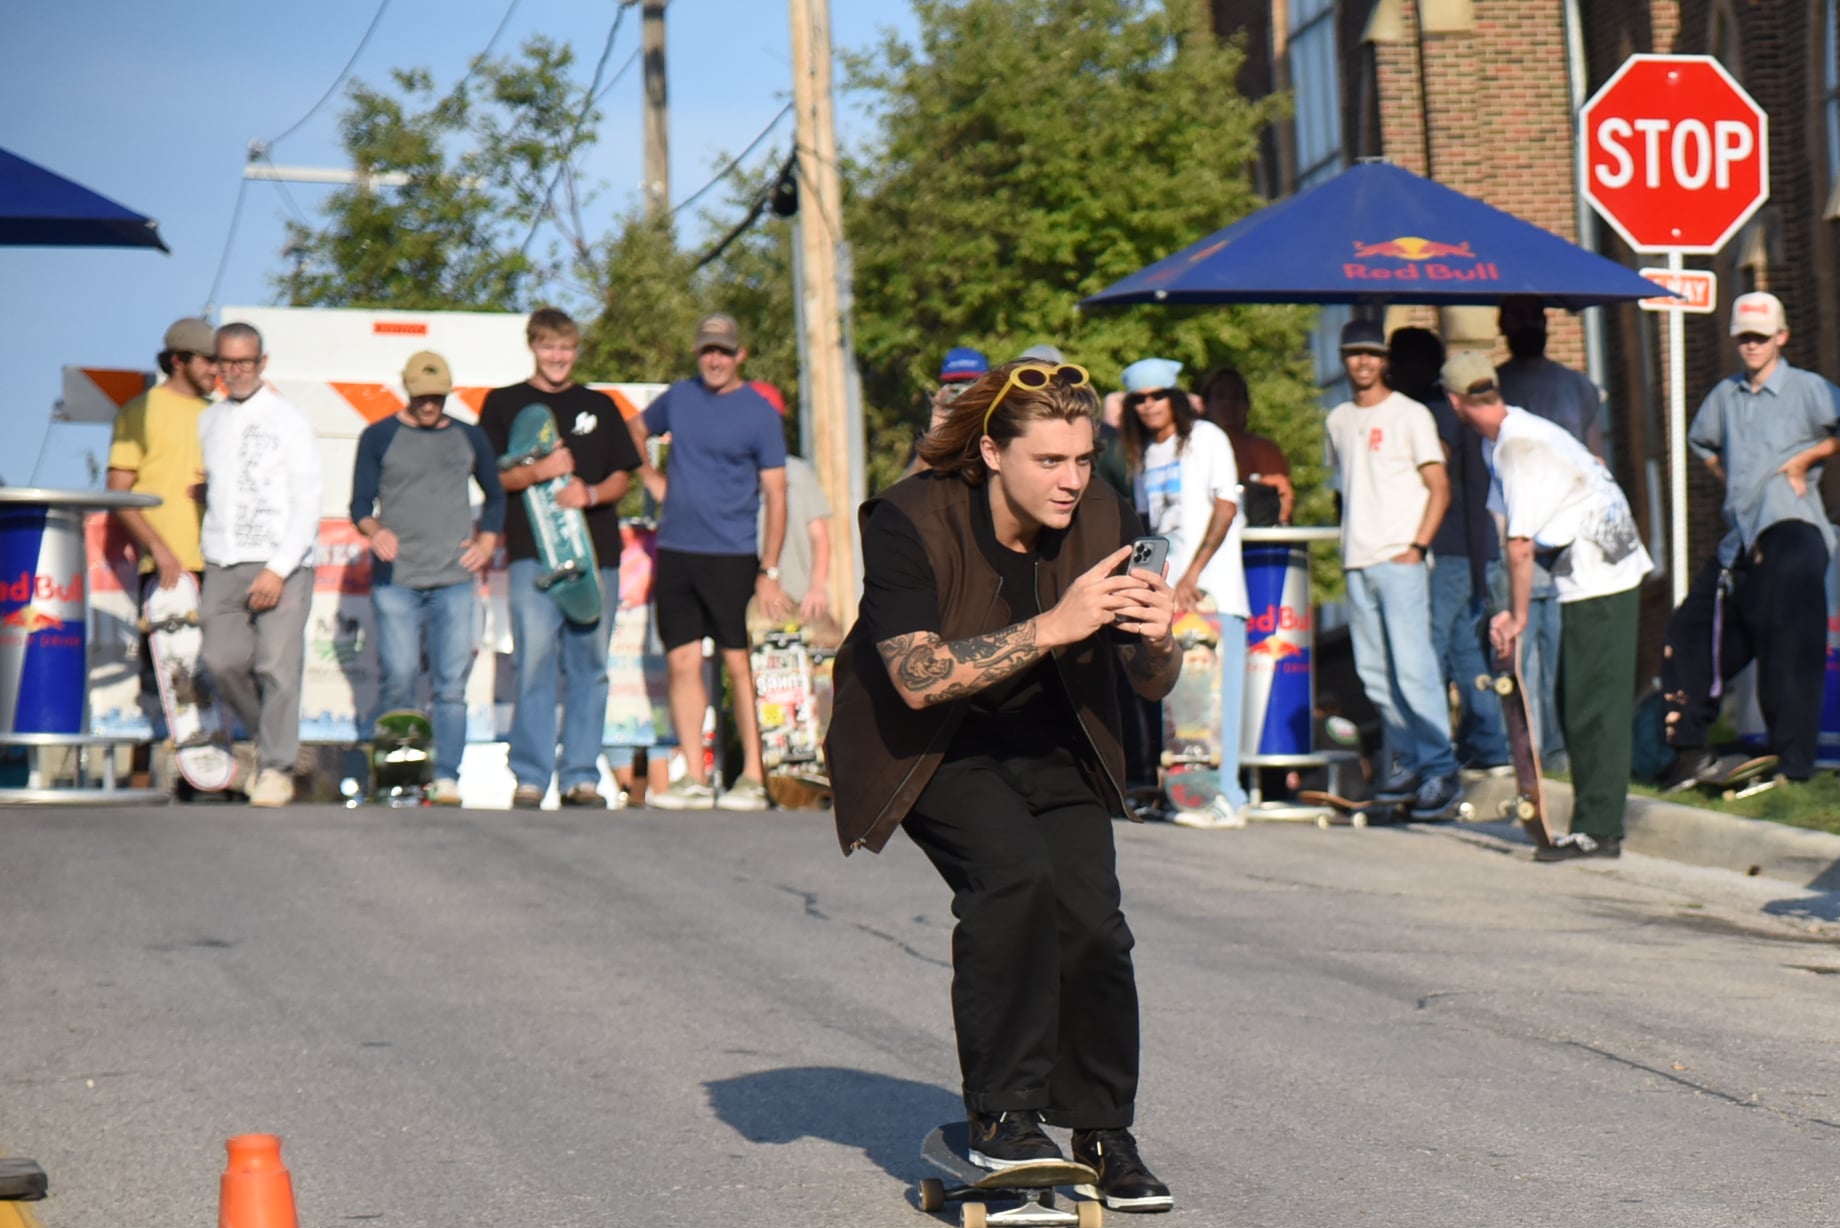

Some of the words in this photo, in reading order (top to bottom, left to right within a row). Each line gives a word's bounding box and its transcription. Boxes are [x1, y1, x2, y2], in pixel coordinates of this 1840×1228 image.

[1594, 116, 1755, 191] STOP
[1342, 262, 1420, 281] Red
[1424, 261, 1500, 281] Bull
